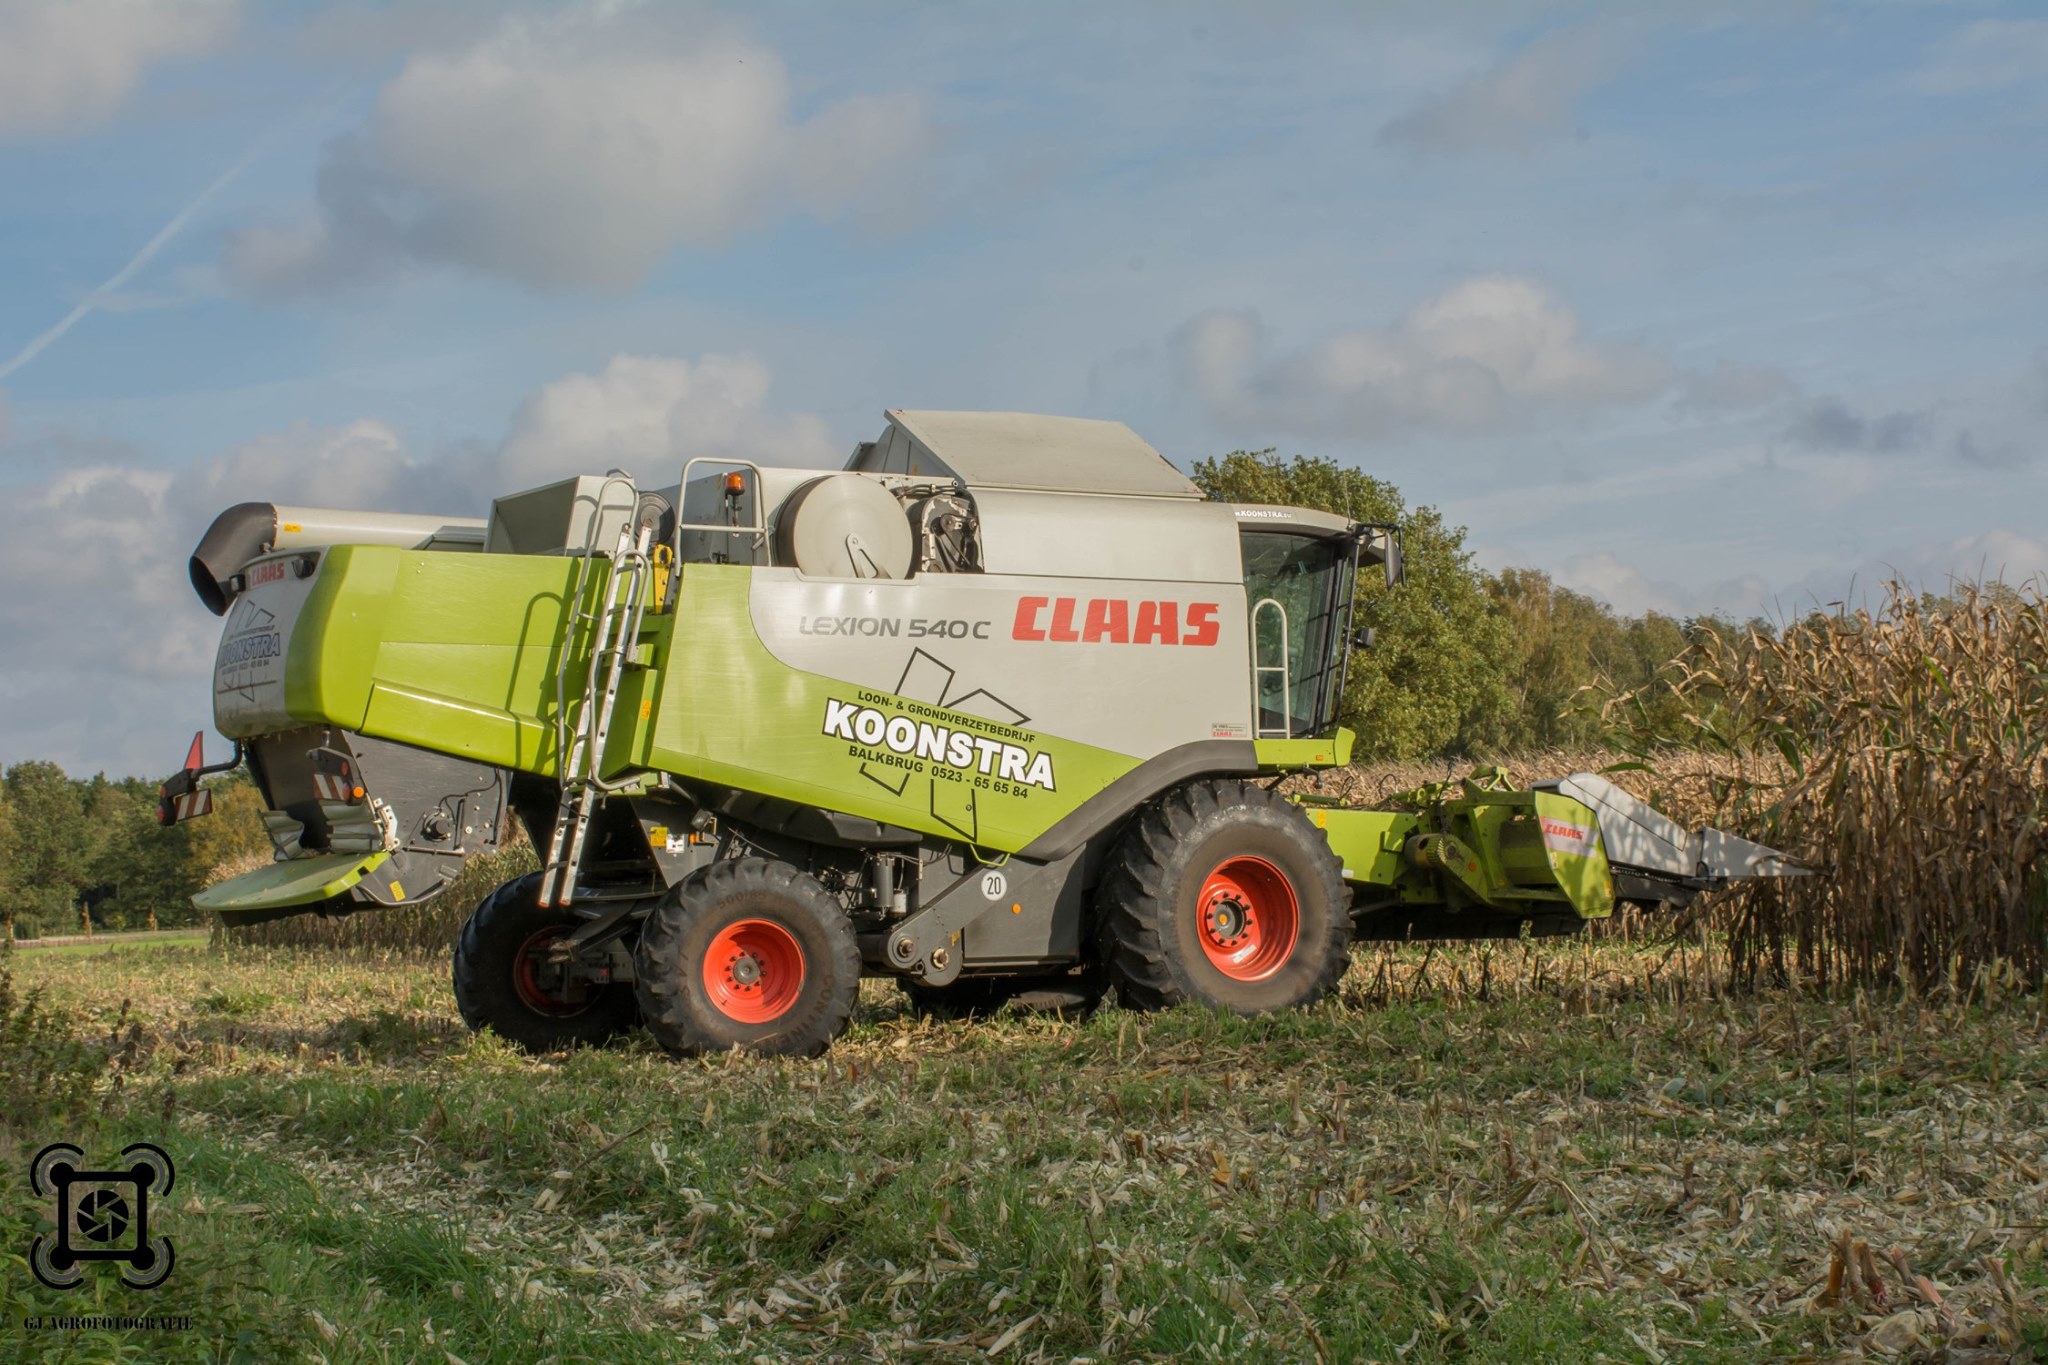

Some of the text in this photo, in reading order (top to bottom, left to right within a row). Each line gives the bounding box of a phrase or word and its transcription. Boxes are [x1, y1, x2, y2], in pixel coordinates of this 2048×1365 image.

[799, 616, 901, 637] LEXION
[1011, 595, 1221, 647] CLAAS
[857, 690, 1036, 744] LOON- & GRONDVERZETBEDRIJF
[822, 697, 1057, 792] KOONSTRA
[848, 745, 924, 773] BALKBRUG
[931, 765, 963, 783] 0523
[974, 776, 990, 790] 65
[993, 780, 1009, 795] 65
[1012, 785, 1029, 799] 84
[1546, 823, 1585, 841] CLAAS
[986, 876, 1001, 896] 20
